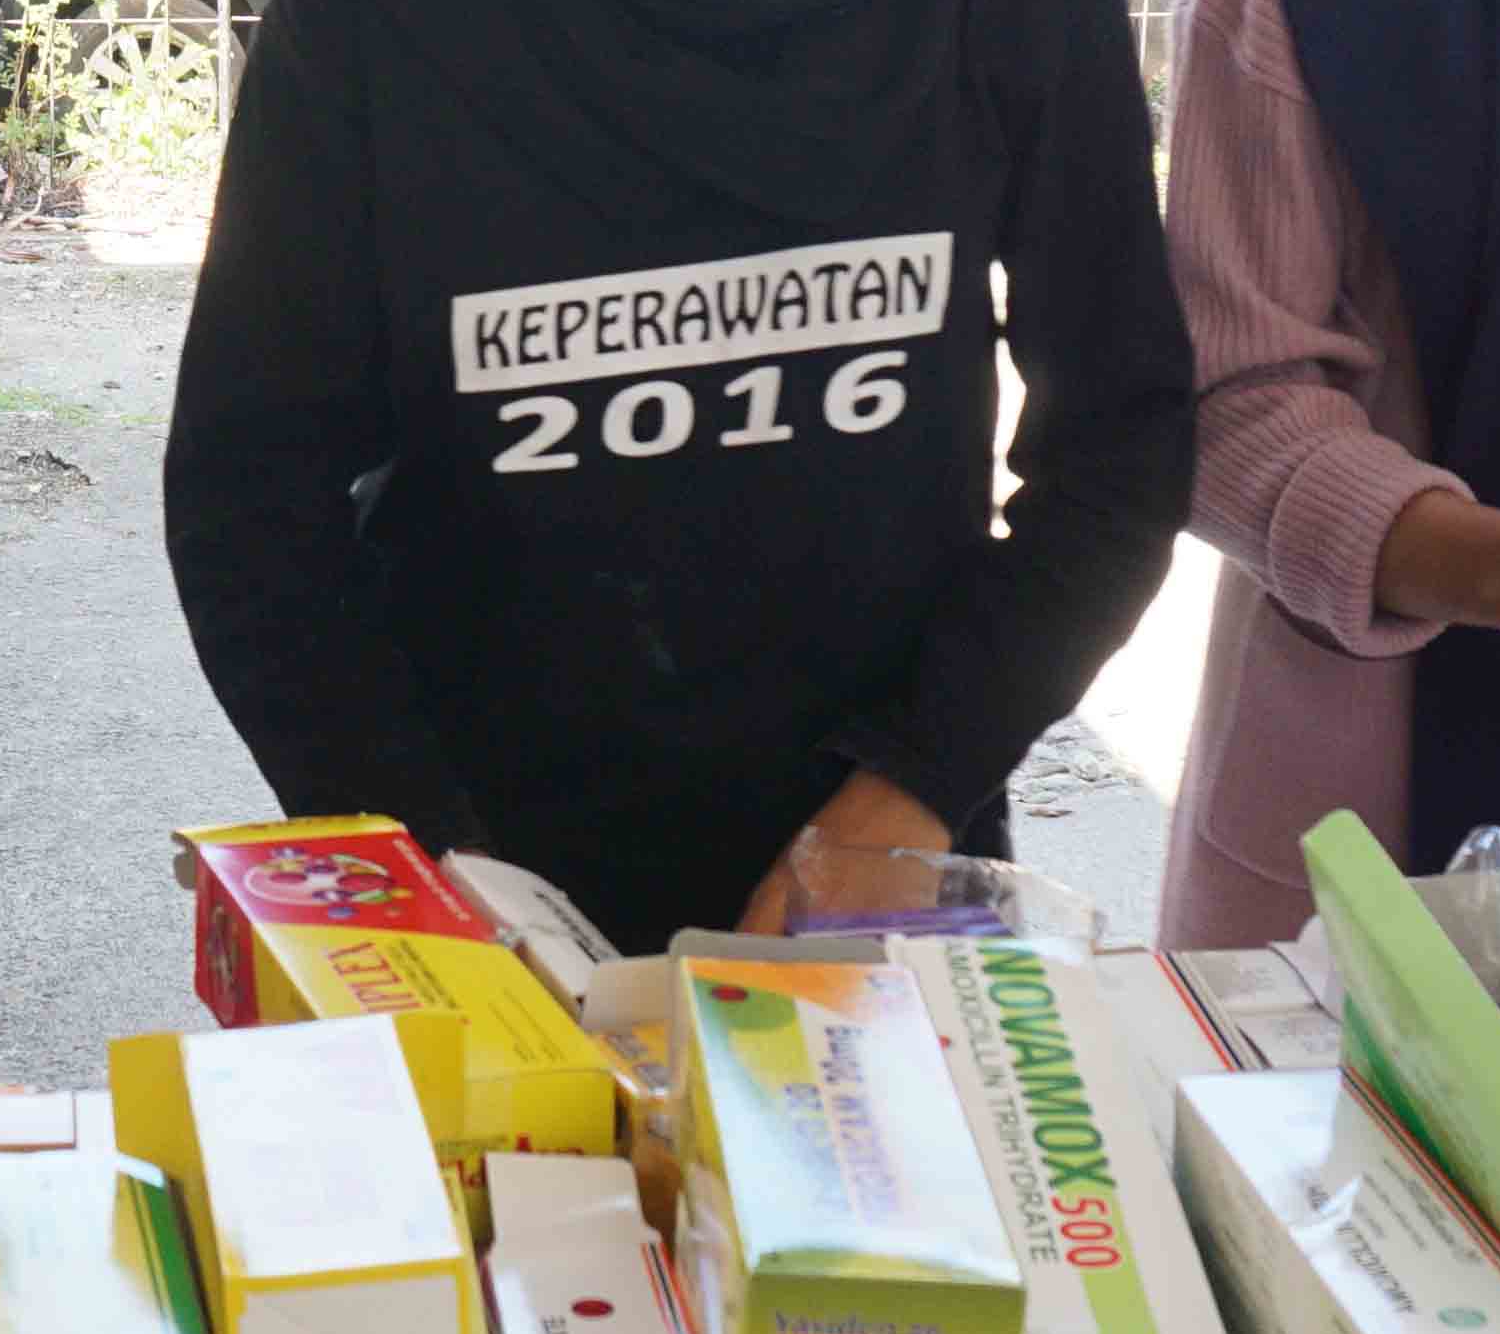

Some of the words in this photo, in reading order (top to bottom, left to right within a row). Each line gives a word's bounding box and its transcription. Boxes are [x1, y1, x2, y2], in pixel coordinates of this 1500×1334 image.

[475, 254, 933, 370] KEPERAWATAN
[492, 351, 908, 473] 2016
[979, 940, 1118, 1190] NOVAMOX
[1052, 1196, 1122, 1269] 500
[989, 1097, 1059, 1265] TRIHYDRATE
